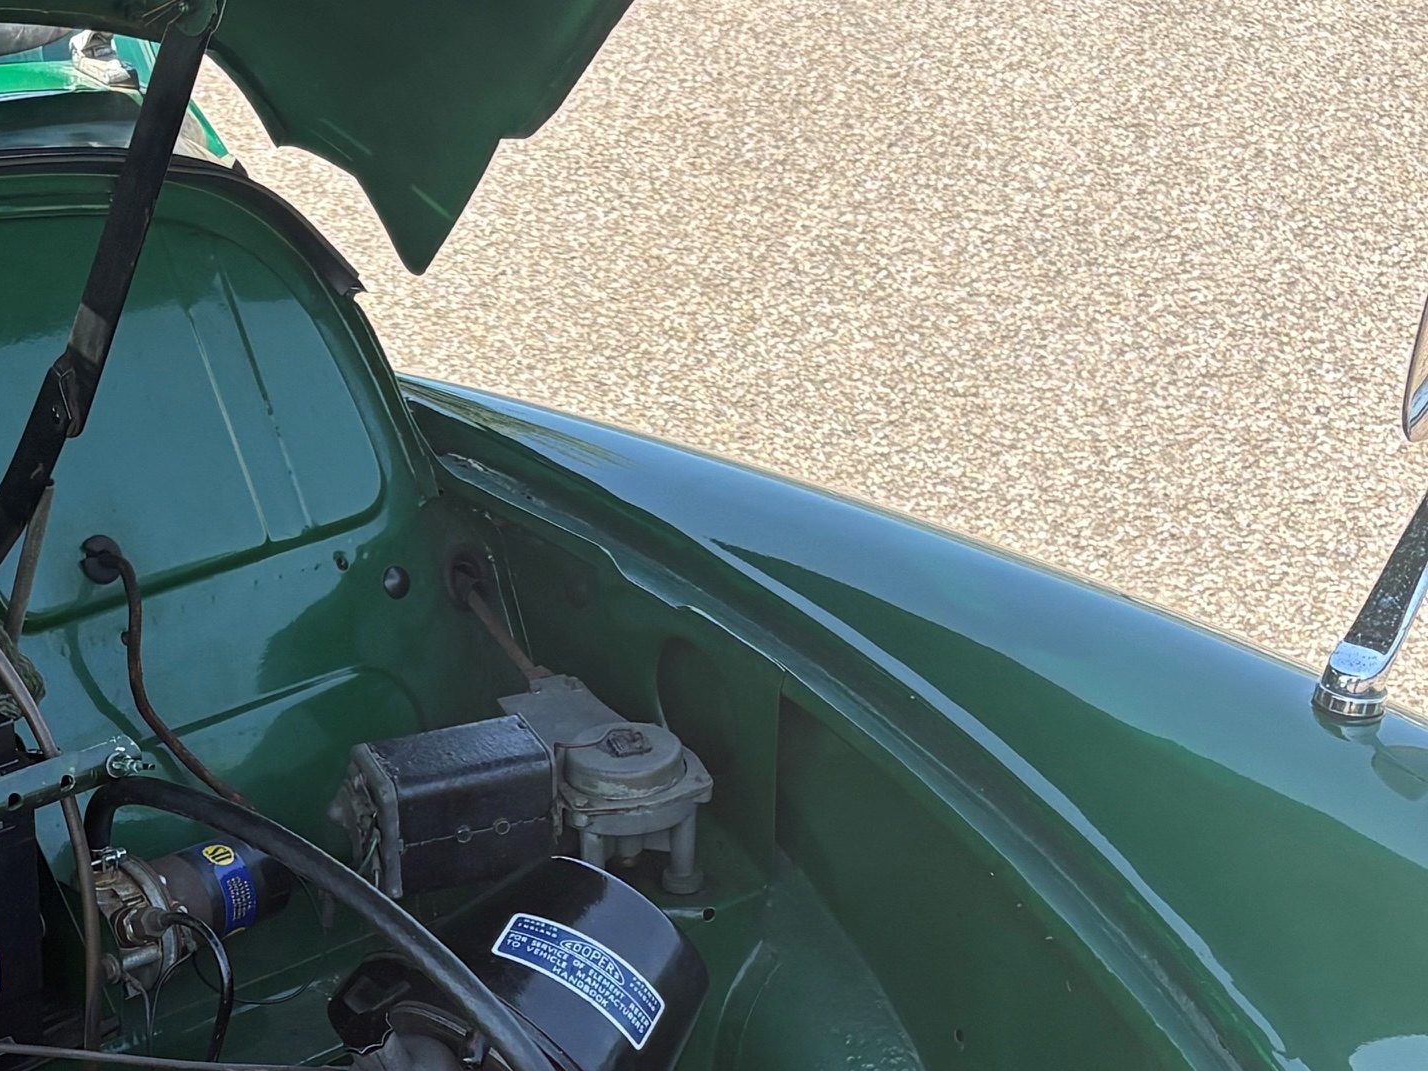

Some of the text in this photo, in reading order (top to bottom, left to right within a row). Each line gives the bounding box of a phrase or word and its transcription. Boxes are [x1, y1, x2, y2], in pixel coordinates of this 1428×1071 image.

[517, 922, 557, 938] ENGLAND
[565, 942, 620, 980] COOPERS
[506, 939, 644, 1034] TO VEHICLE MANUFACTURERS
[508, 933, 650, 1028] FOR SERVICE OF ELEMENT REFER
